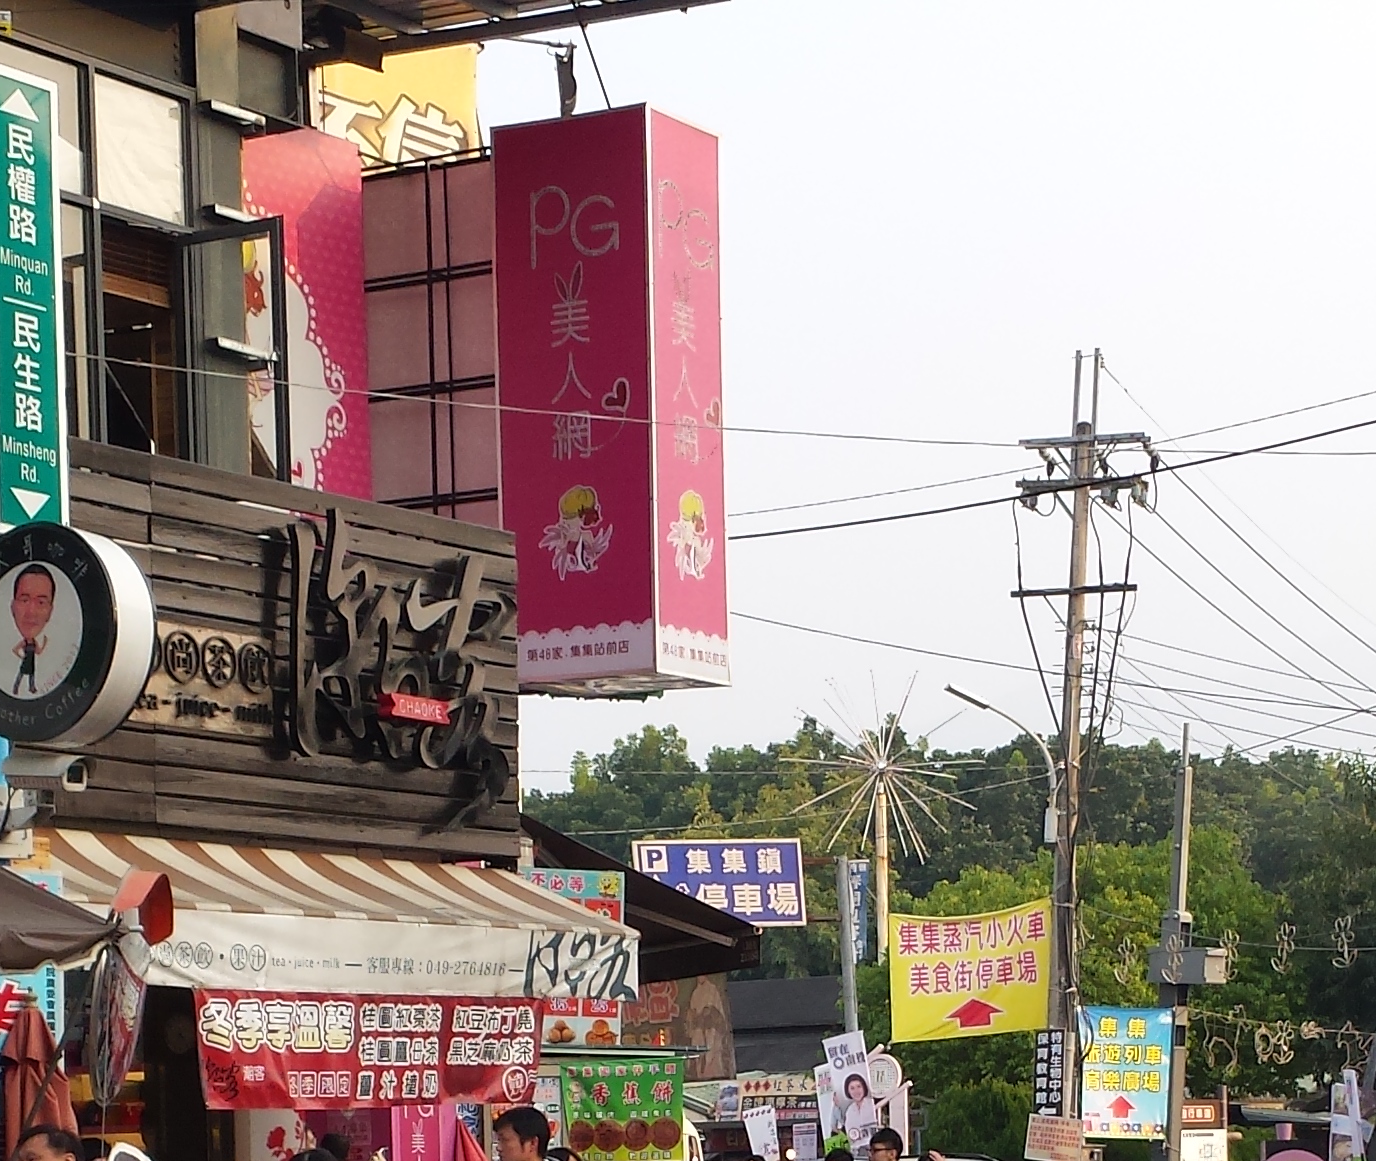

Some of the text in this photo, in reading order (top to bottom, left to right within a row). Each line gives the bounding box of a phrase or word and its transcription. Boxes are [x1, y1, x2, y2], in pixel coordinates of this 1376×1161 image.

[6, 124, 38, 247] 民權路
[530, 185, 619, 269] PG
[657, 178, 714, 271] PG
[0, 246, 48, 296] Minquan Rd.
[12, 312, 42, 433] 民生路
[550, 262, 592, 459] 美人網
[671, 270, 699, 466] 美人網
[2, 435, 57, 484] Minsheng Rd.
[154, 631, 271, 693] 尚茶飲
[45, 677, 90, 720] Coffee
[399, 699, 442, 718] CHAOKE
[647, 848, 663, 869] P
[686, 848, 782, 875] 集集鎮
[531, 872, 585, 893] 不必等
[696, 883, 799, 916] 停車場
[899, 911, 1046, 955] 集集蒸汽小火車
[230, 944, 266, 971] 果汁
[272, 957, 340, 969] tea juice milk
[426, 960, 506, 976] 049-2764816
[910, 951, 1037, 995] 美食街停車場
[201, 999, 355, 1053] 冬季享溫馨
[1099, 1016, 1146, 1039] 集集
[446, 1037, 535, 1066] 黑芝麻奶茶
[288, 1071, 352, 1097] 冬季限定
[591, 1080, 673, 1106] 香蕉餅
